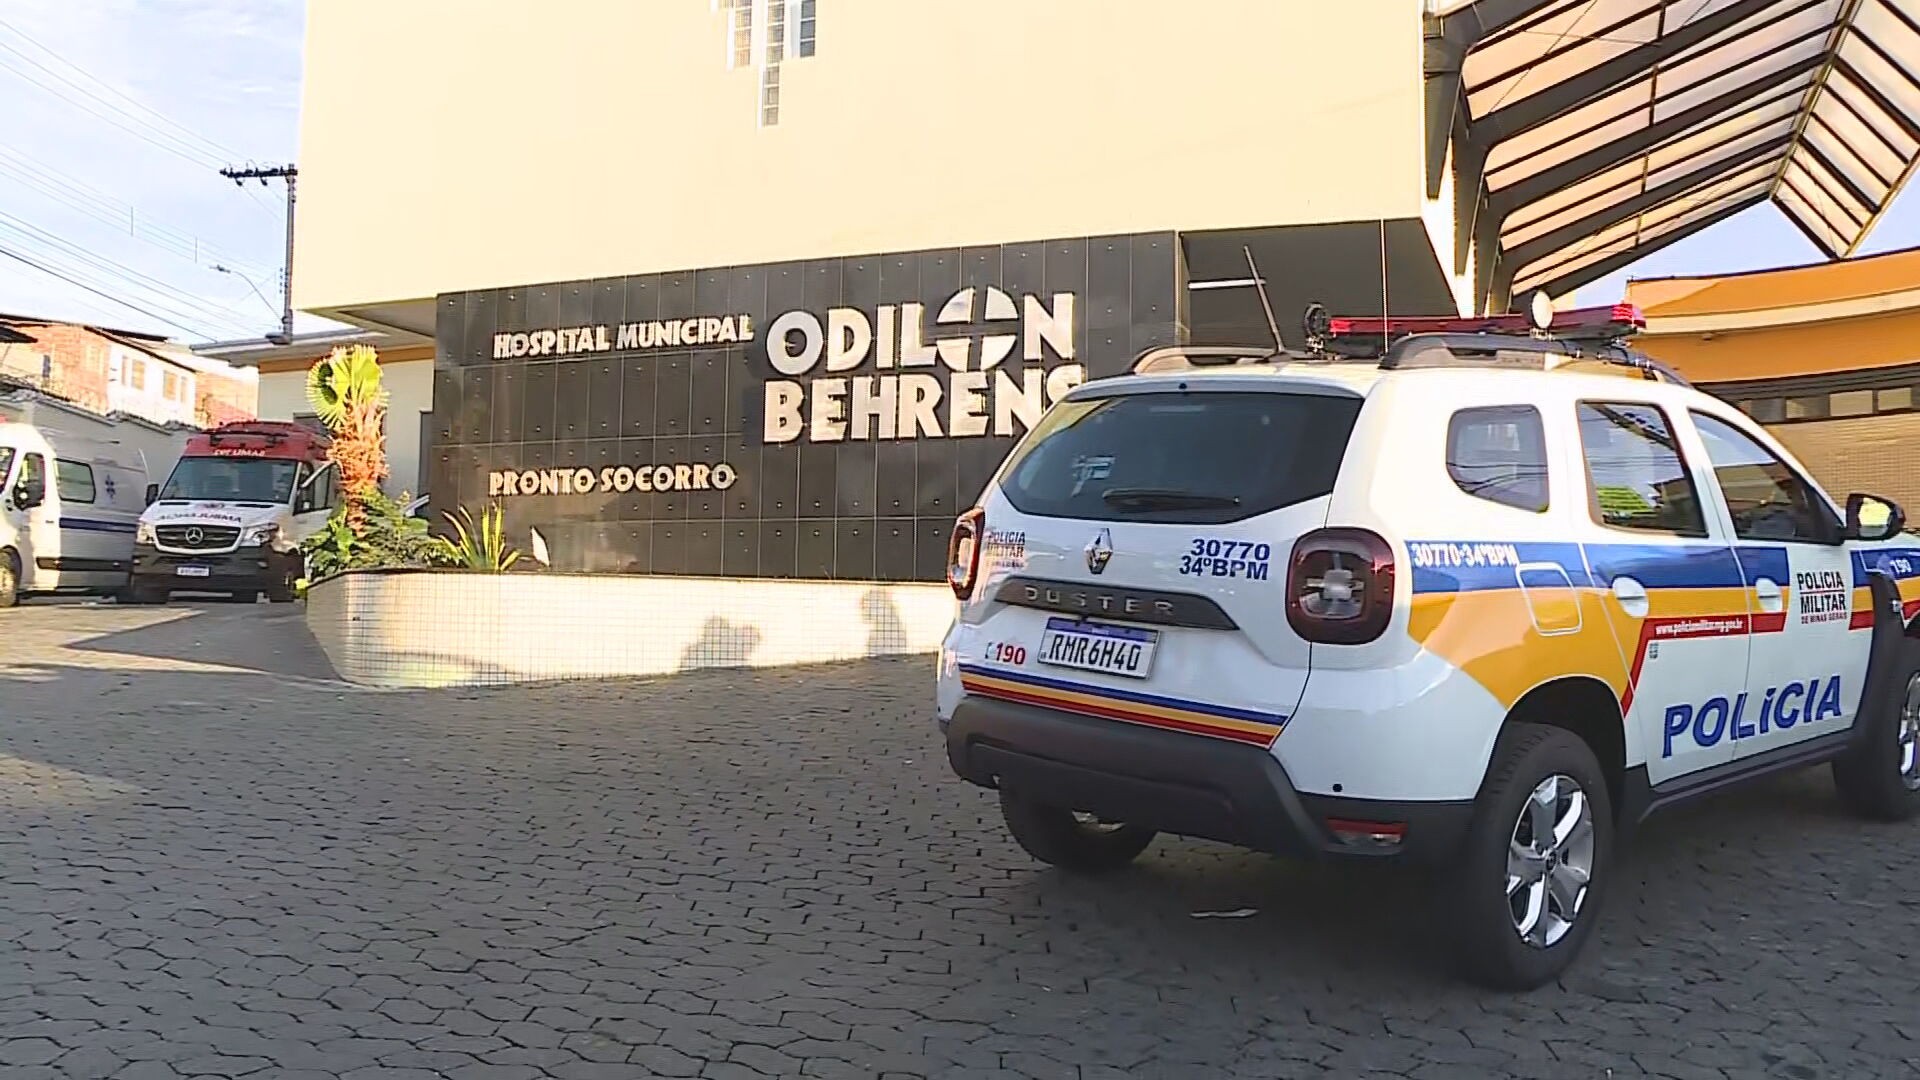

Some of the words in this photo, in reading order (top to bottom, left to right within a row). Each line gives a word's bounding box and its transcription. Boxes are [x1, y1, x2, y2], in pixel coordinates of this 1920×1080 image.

[492, 325, 610, 360] HOSPITAL
[616, 314, 755, 351] MUNICIPAL
[766, 286, 1075, 375] ODILON
[488, 470, 597, 497] PRONTO
[600, 462, 737, 492] SOCORRO
[1190, 538, 1270, 561] 30770
[1024, 585, 1175, 615] DUSTER
[1800, 593, 1846, 614] MILITAR
[996, 642, 1026, 665] 190
[1049, 634, 1142, 671] RMR6H40
